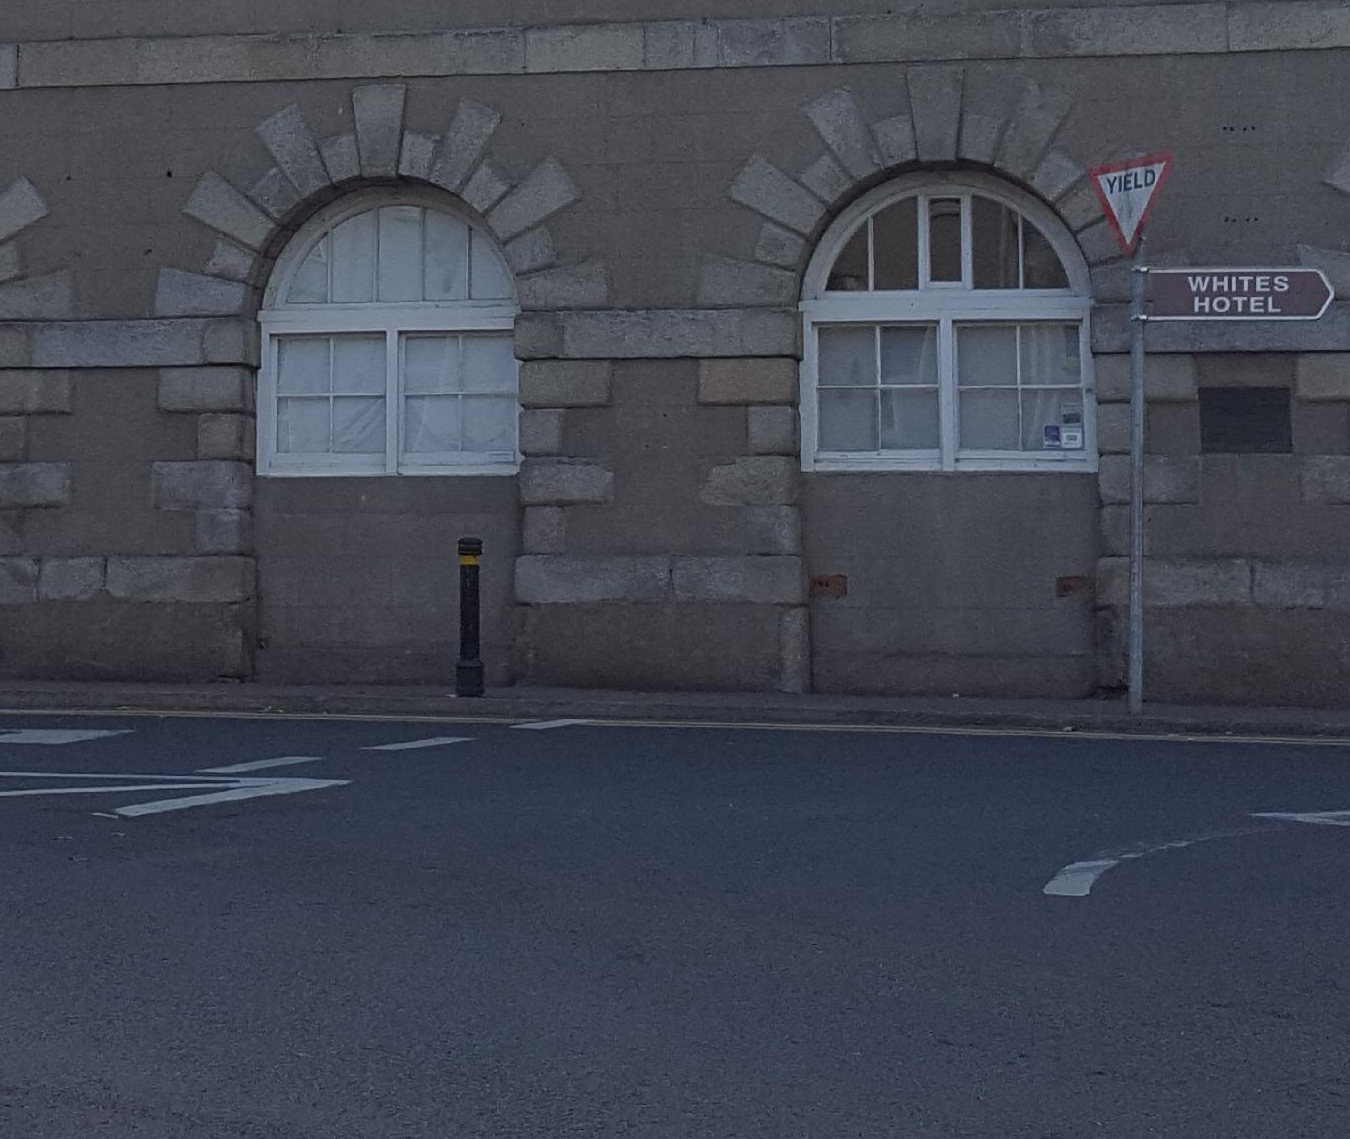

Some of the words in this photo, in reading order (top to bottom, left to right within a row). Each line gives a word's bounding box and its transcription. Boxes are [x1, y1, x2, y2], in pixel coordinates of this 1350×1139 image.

[1106, 168, 1157, 195] YIELD
[1187, 275, 1290, 293] WHITES
[1193, 296, 1282, 313] HOTEL
